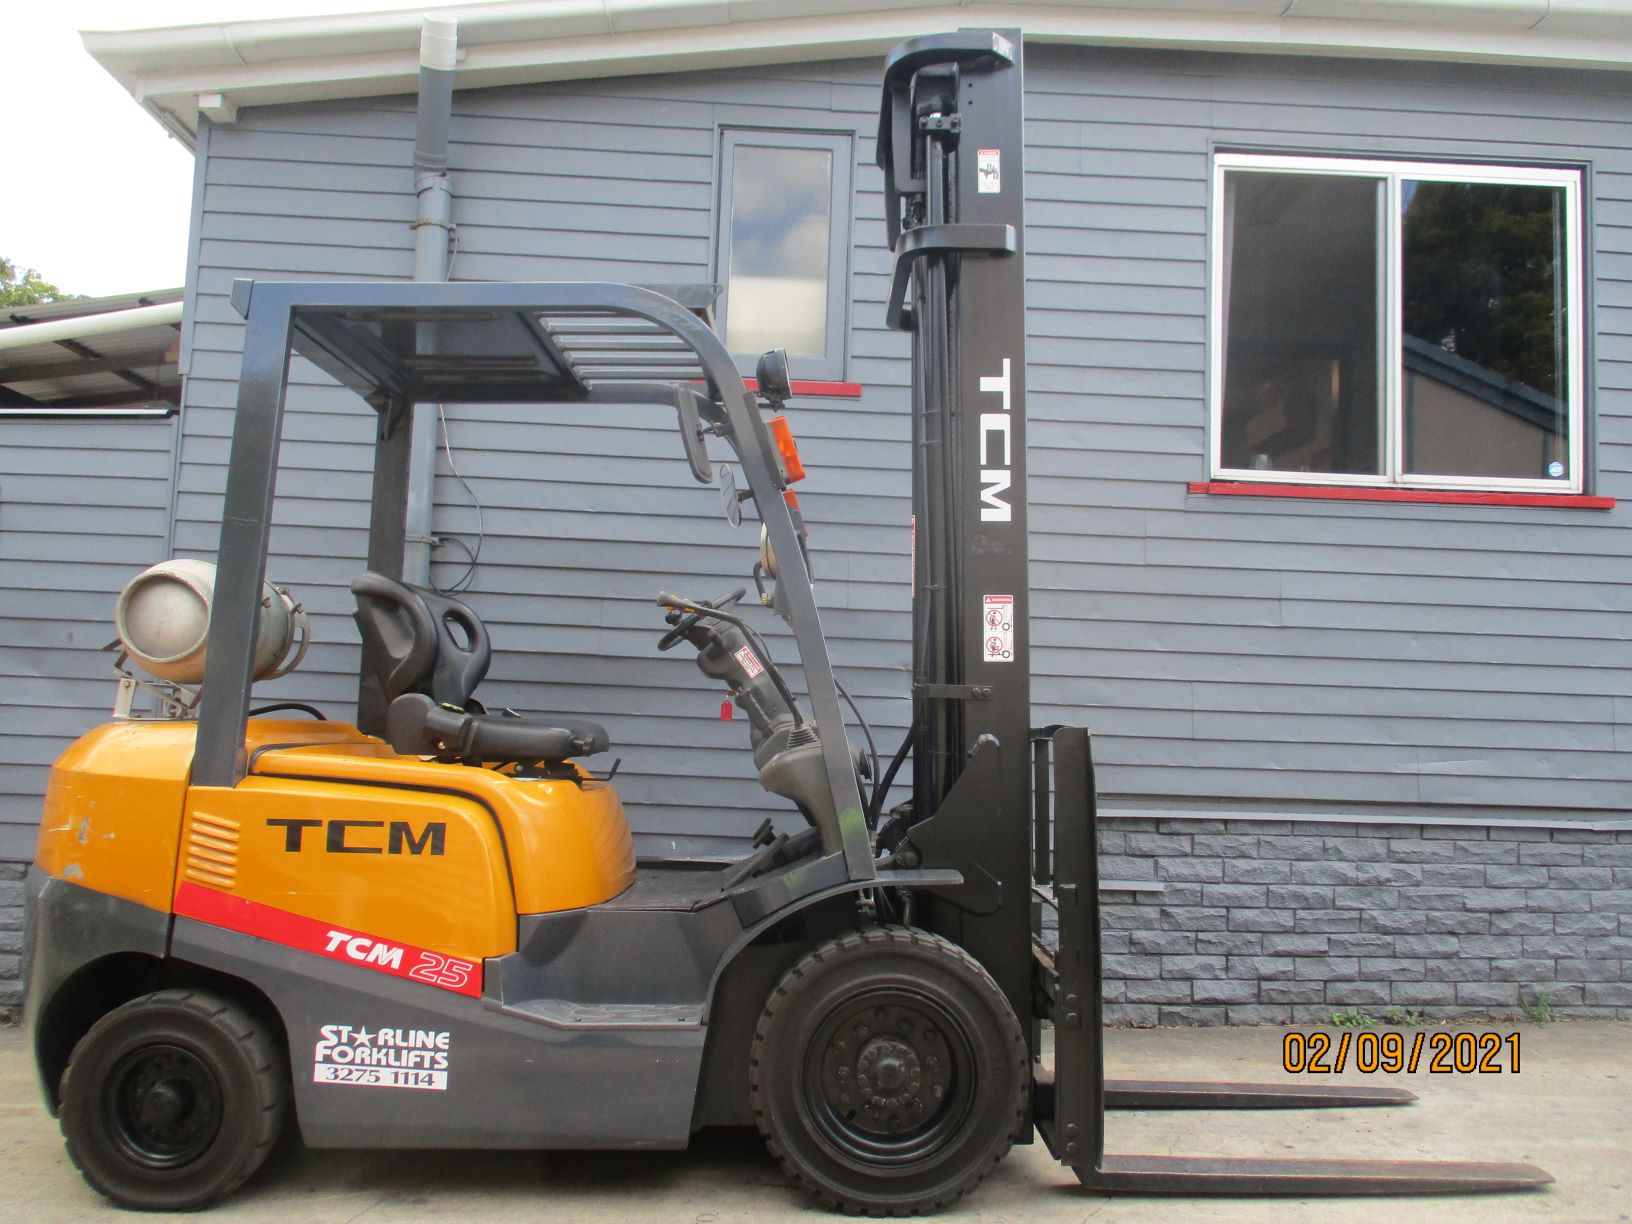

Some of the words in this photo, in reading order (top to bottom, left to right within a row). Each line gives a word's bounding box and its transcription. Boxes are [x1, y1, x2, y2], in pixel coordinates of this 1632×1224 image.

[980, 358, 1011, 522] TCM
[266, 818, 447, 856] TCM
[325, 930, 404, 970] TCM
[409, 952, 473, 988] 25
[314, 1040, 449, 1070] FORKLIFTS
[326, 1066, 381, 1083] 3275
[390, 1071, 435, 1087] 1114
